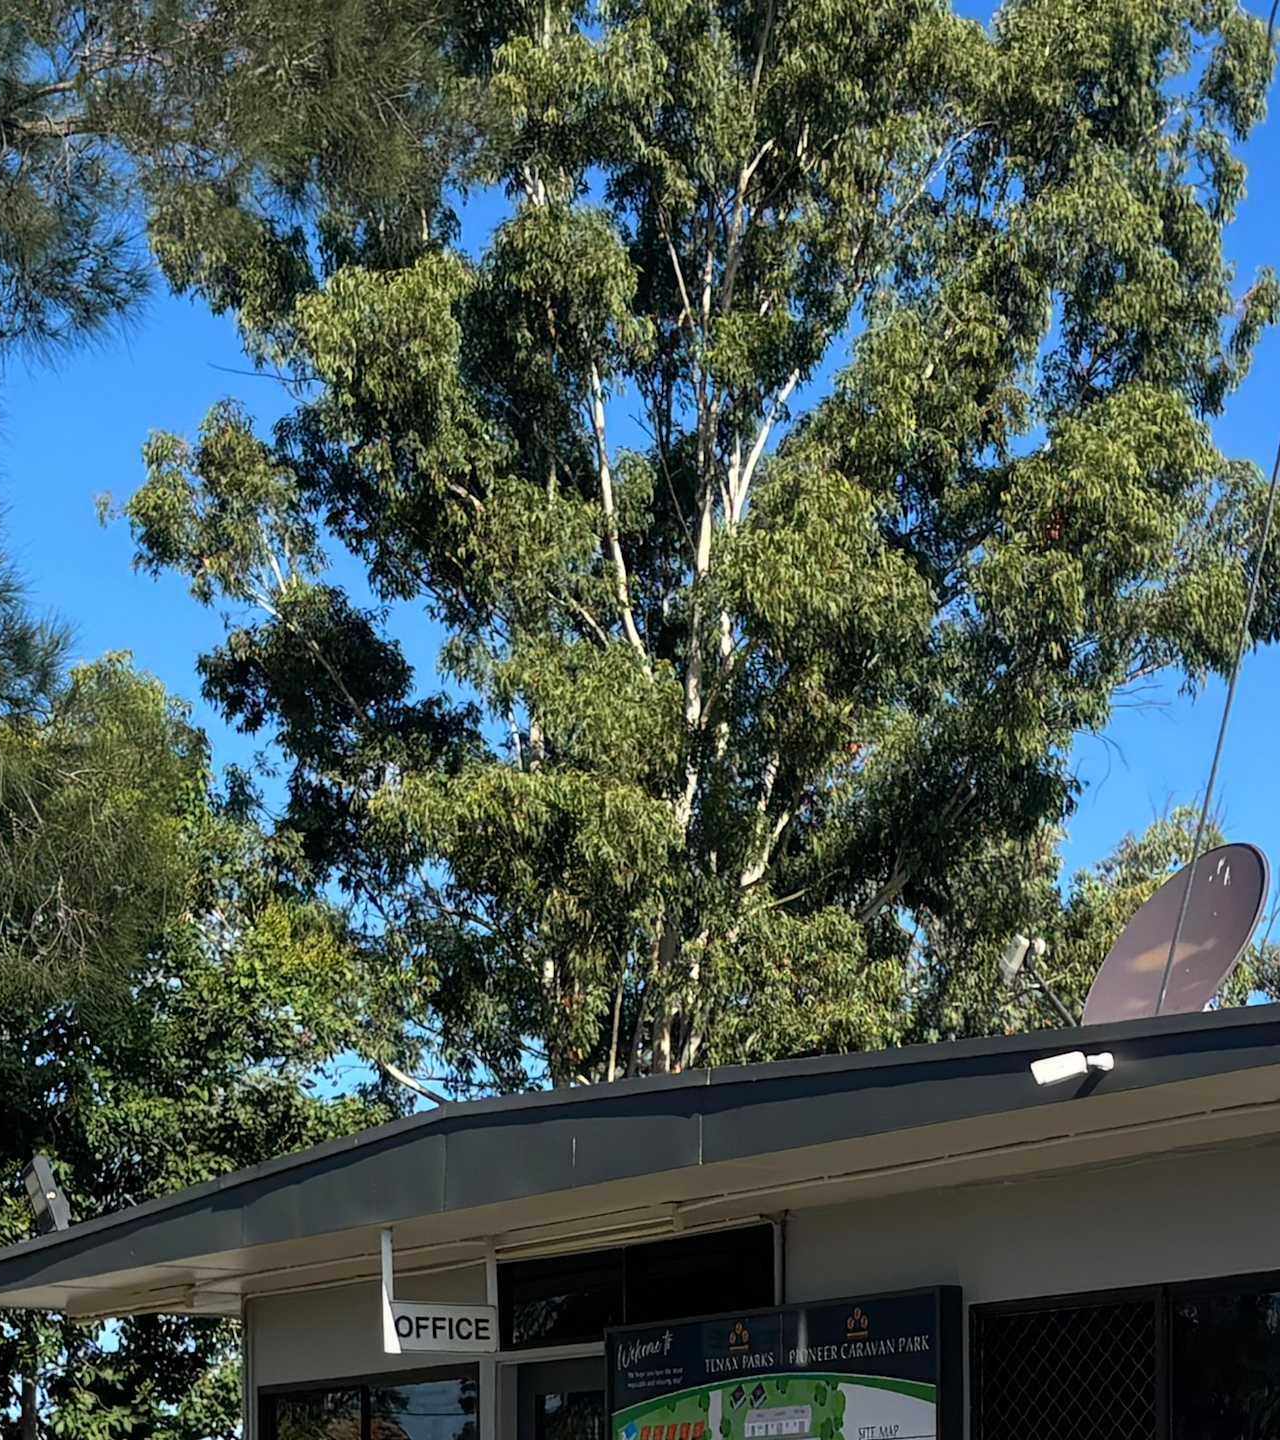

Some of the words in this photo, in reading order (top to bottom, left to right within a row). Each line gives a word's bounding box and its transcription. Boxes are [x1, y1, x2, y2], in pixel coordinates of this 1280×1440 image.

[394, 1315, 491, 1340] OFFICE
[788, 1345, 838, 1365] PIONEER
[840, 1338, 895, 1360] CARAVAN
[898, 1334, 930, 1353] PARK
[705, 1355, 739, 1374] TENAX
[741, 1351, 776, 1370] PARKS
[858, 1426, 876, 1439] SITE
[879, 1424, 900, 1437] MAP
